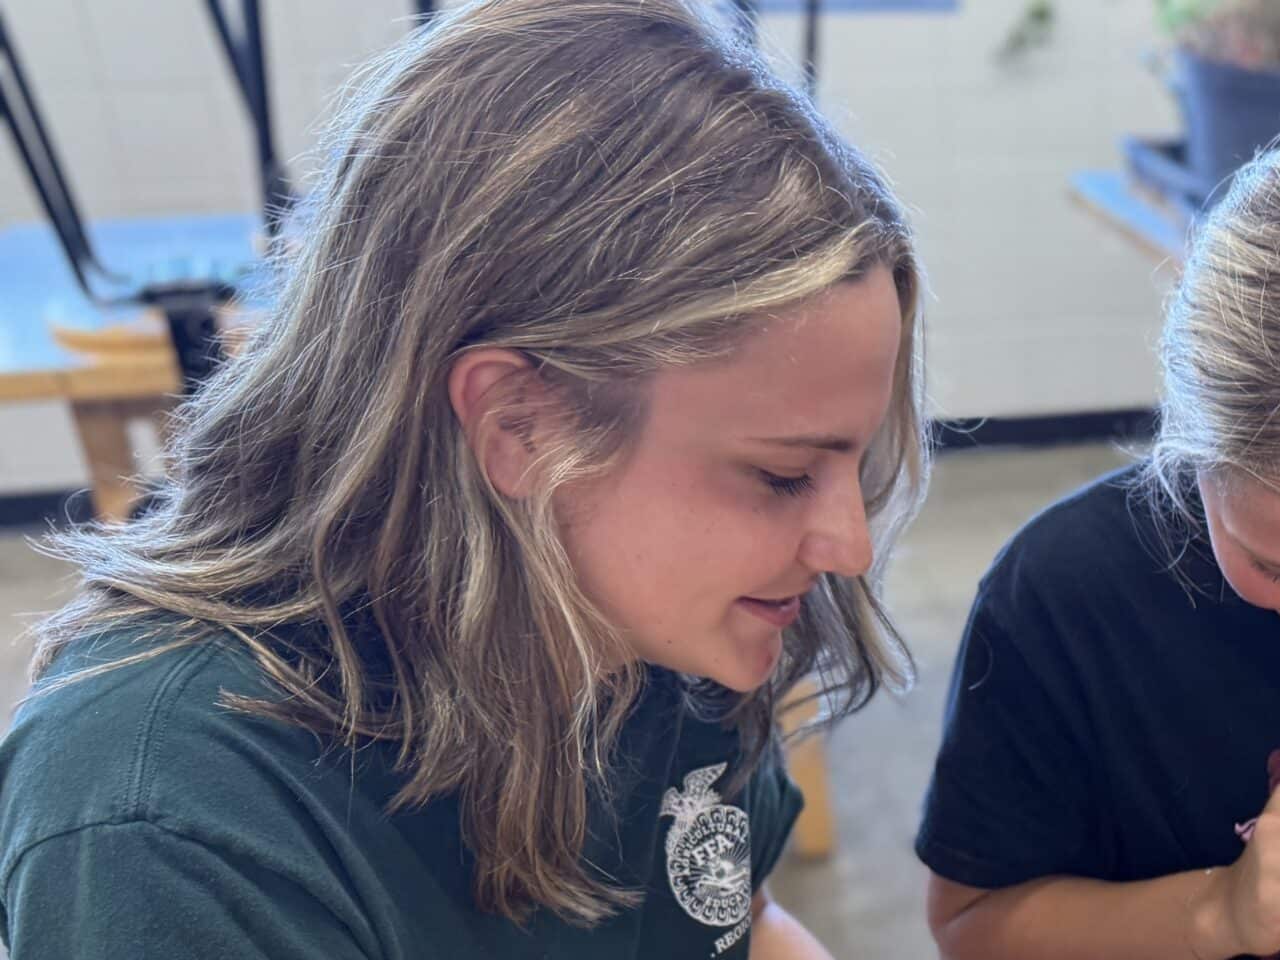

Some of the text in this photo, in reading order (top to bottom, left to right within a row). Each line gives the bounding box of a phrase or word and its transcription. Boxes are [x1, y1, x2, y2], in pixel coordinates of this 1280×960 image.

[692, 833, 735, 867] FFA
[704, 894, 742, 908] EDUCA
[714, 914, 752, 954] REGIO
